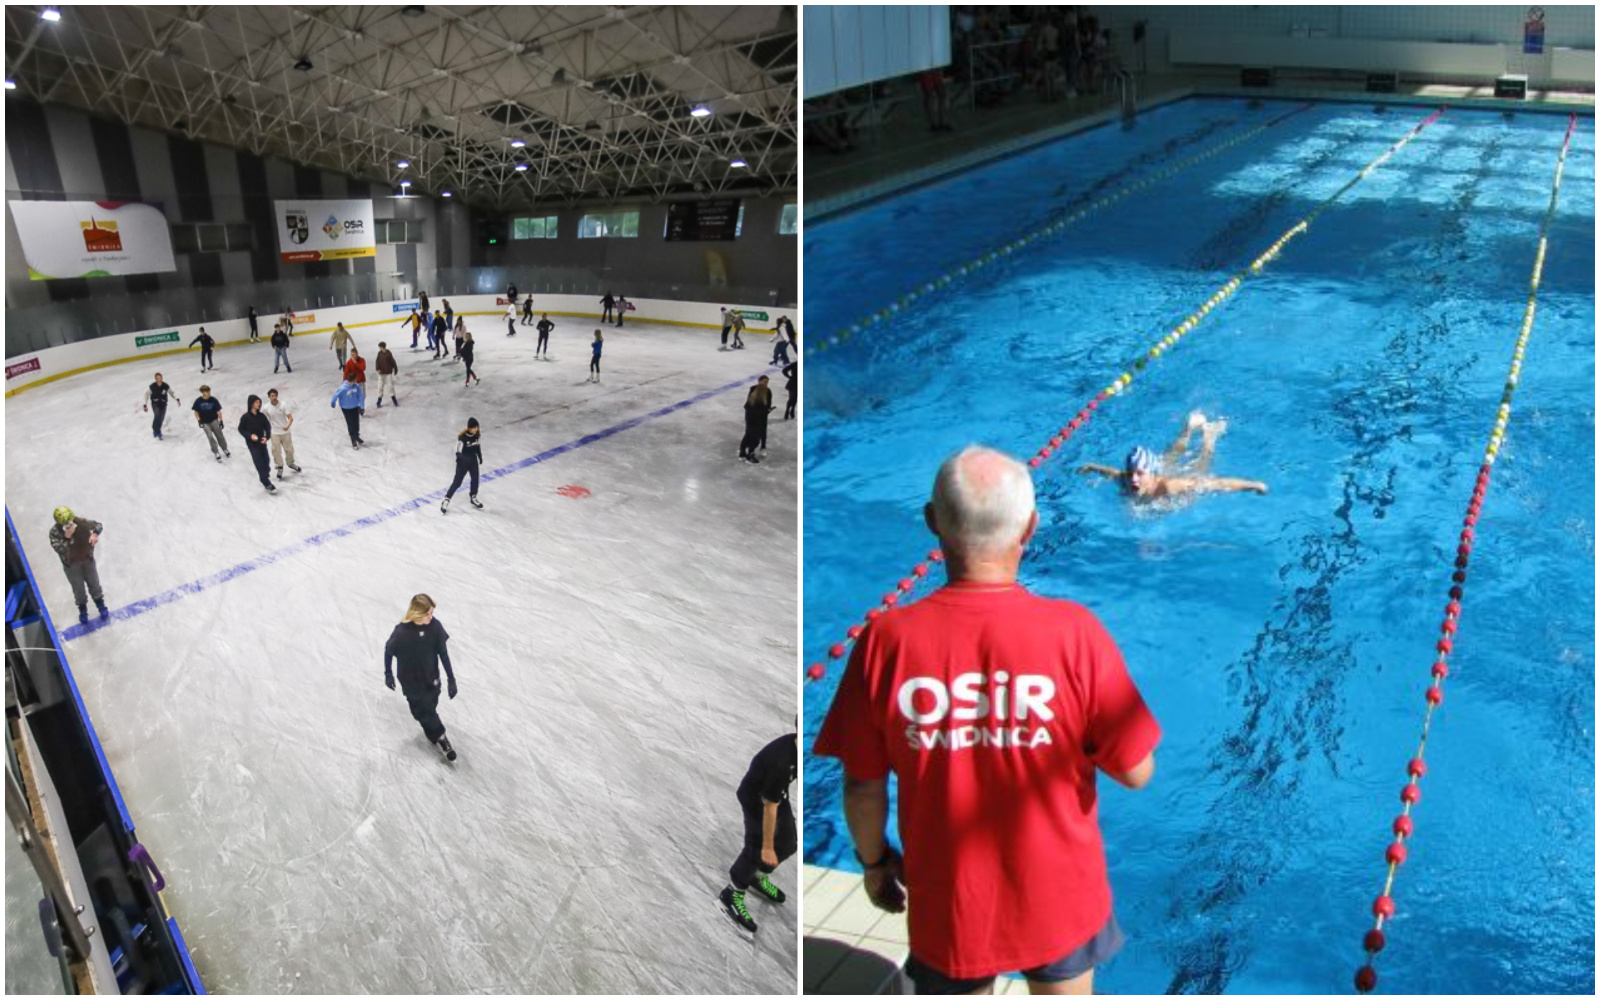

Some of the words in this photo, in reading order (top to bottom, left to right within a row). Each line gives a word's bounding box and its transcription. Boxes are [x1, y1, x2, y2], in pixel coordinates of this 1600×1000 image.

[144, 334, 171, 344] ŚWIDNICA
[897, 670, 1056, 725] OSiR
[905, 723, 1052, 751] ŚWIDNICA
